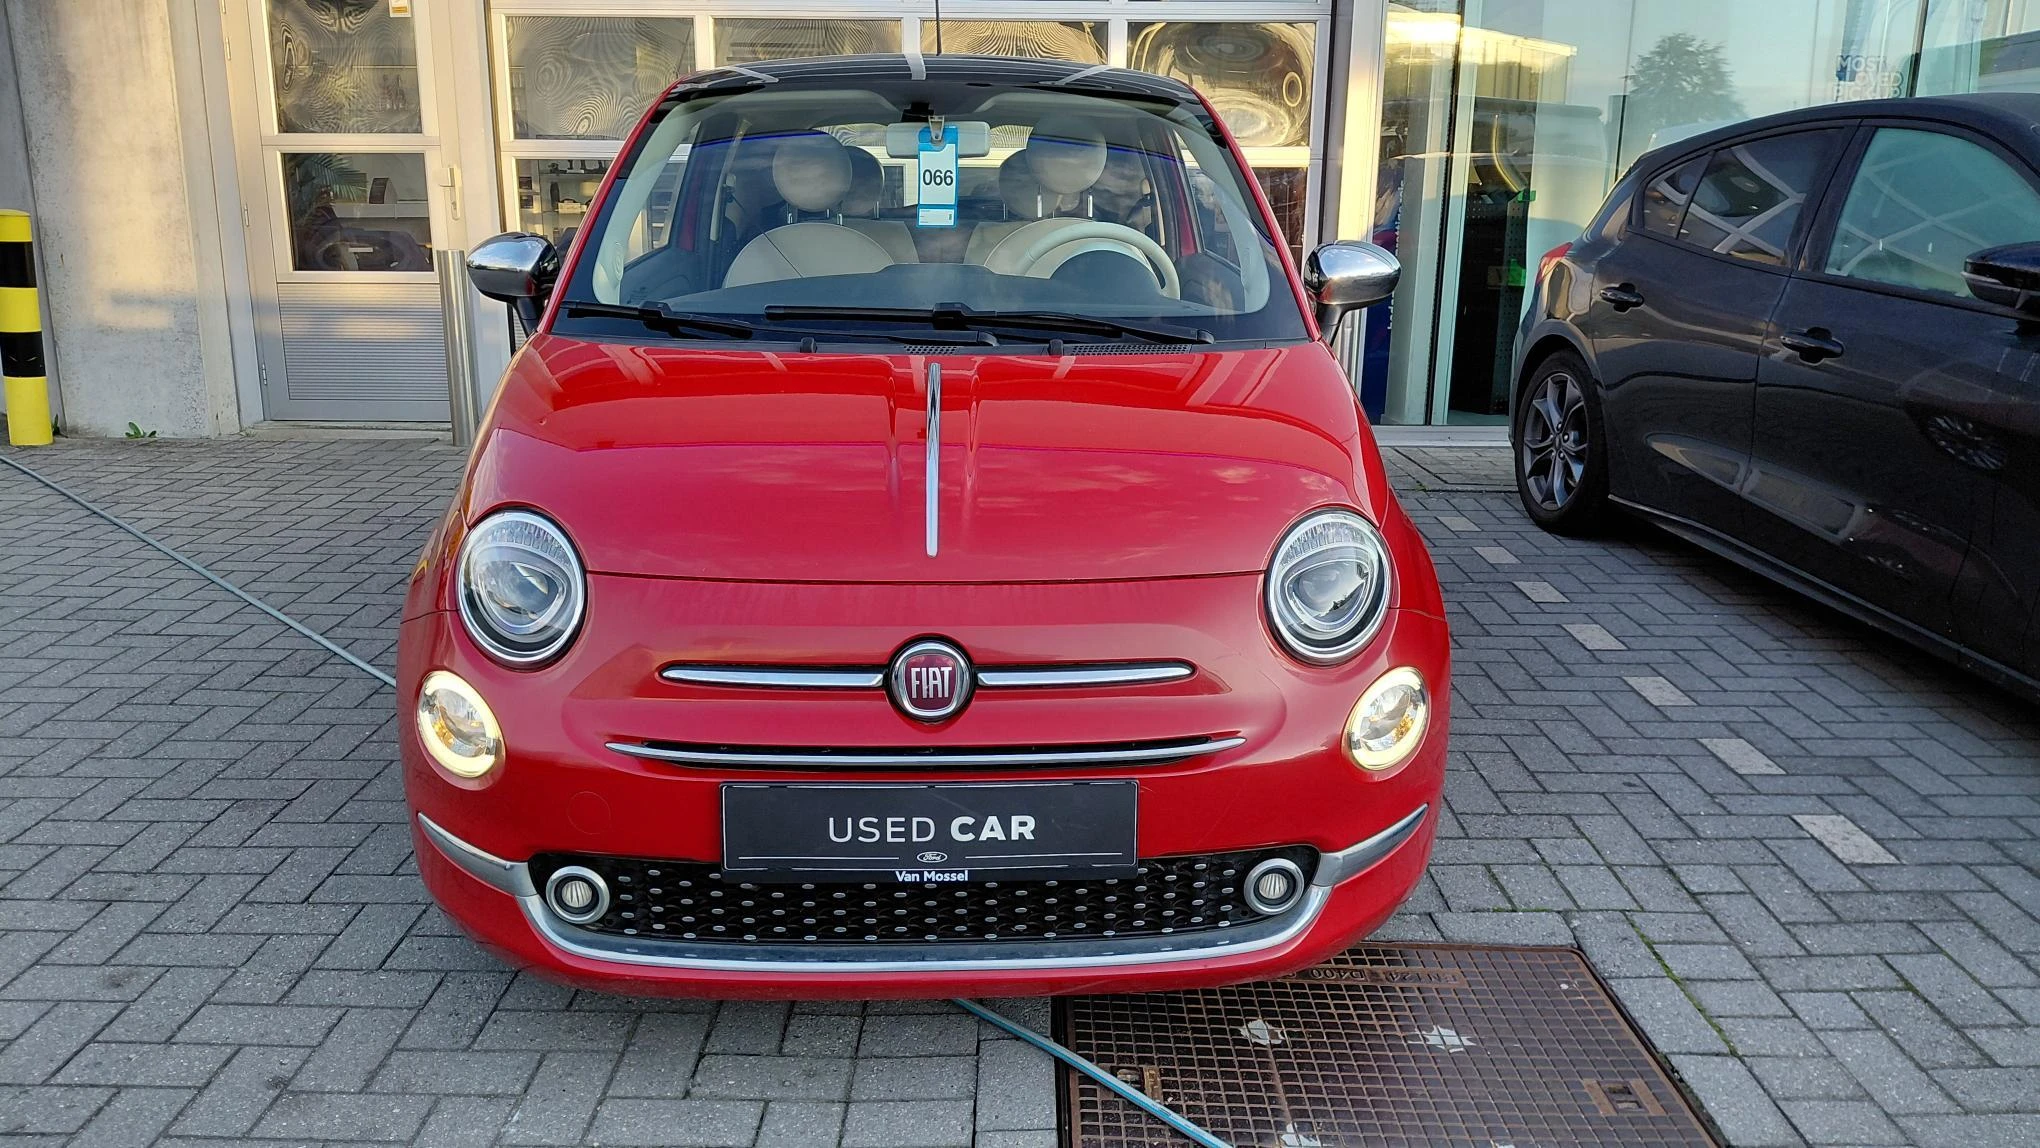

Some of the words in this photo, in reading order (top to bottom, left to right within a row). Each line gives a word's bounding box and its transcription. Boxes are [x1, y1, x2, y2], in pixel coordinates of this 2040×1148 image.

[922, 169, 954, 187] 066
[910, 666, 953, 699] FIAT
[828, 816, 936, 843] USED
[950, 815, 1036, 842] CAR
[920, 852, 944, 862] Ford
[895, 870, 920, 882] Van
[923, 869, 969, 882] Mossel
[1309, 967, 1367, 981] D400
